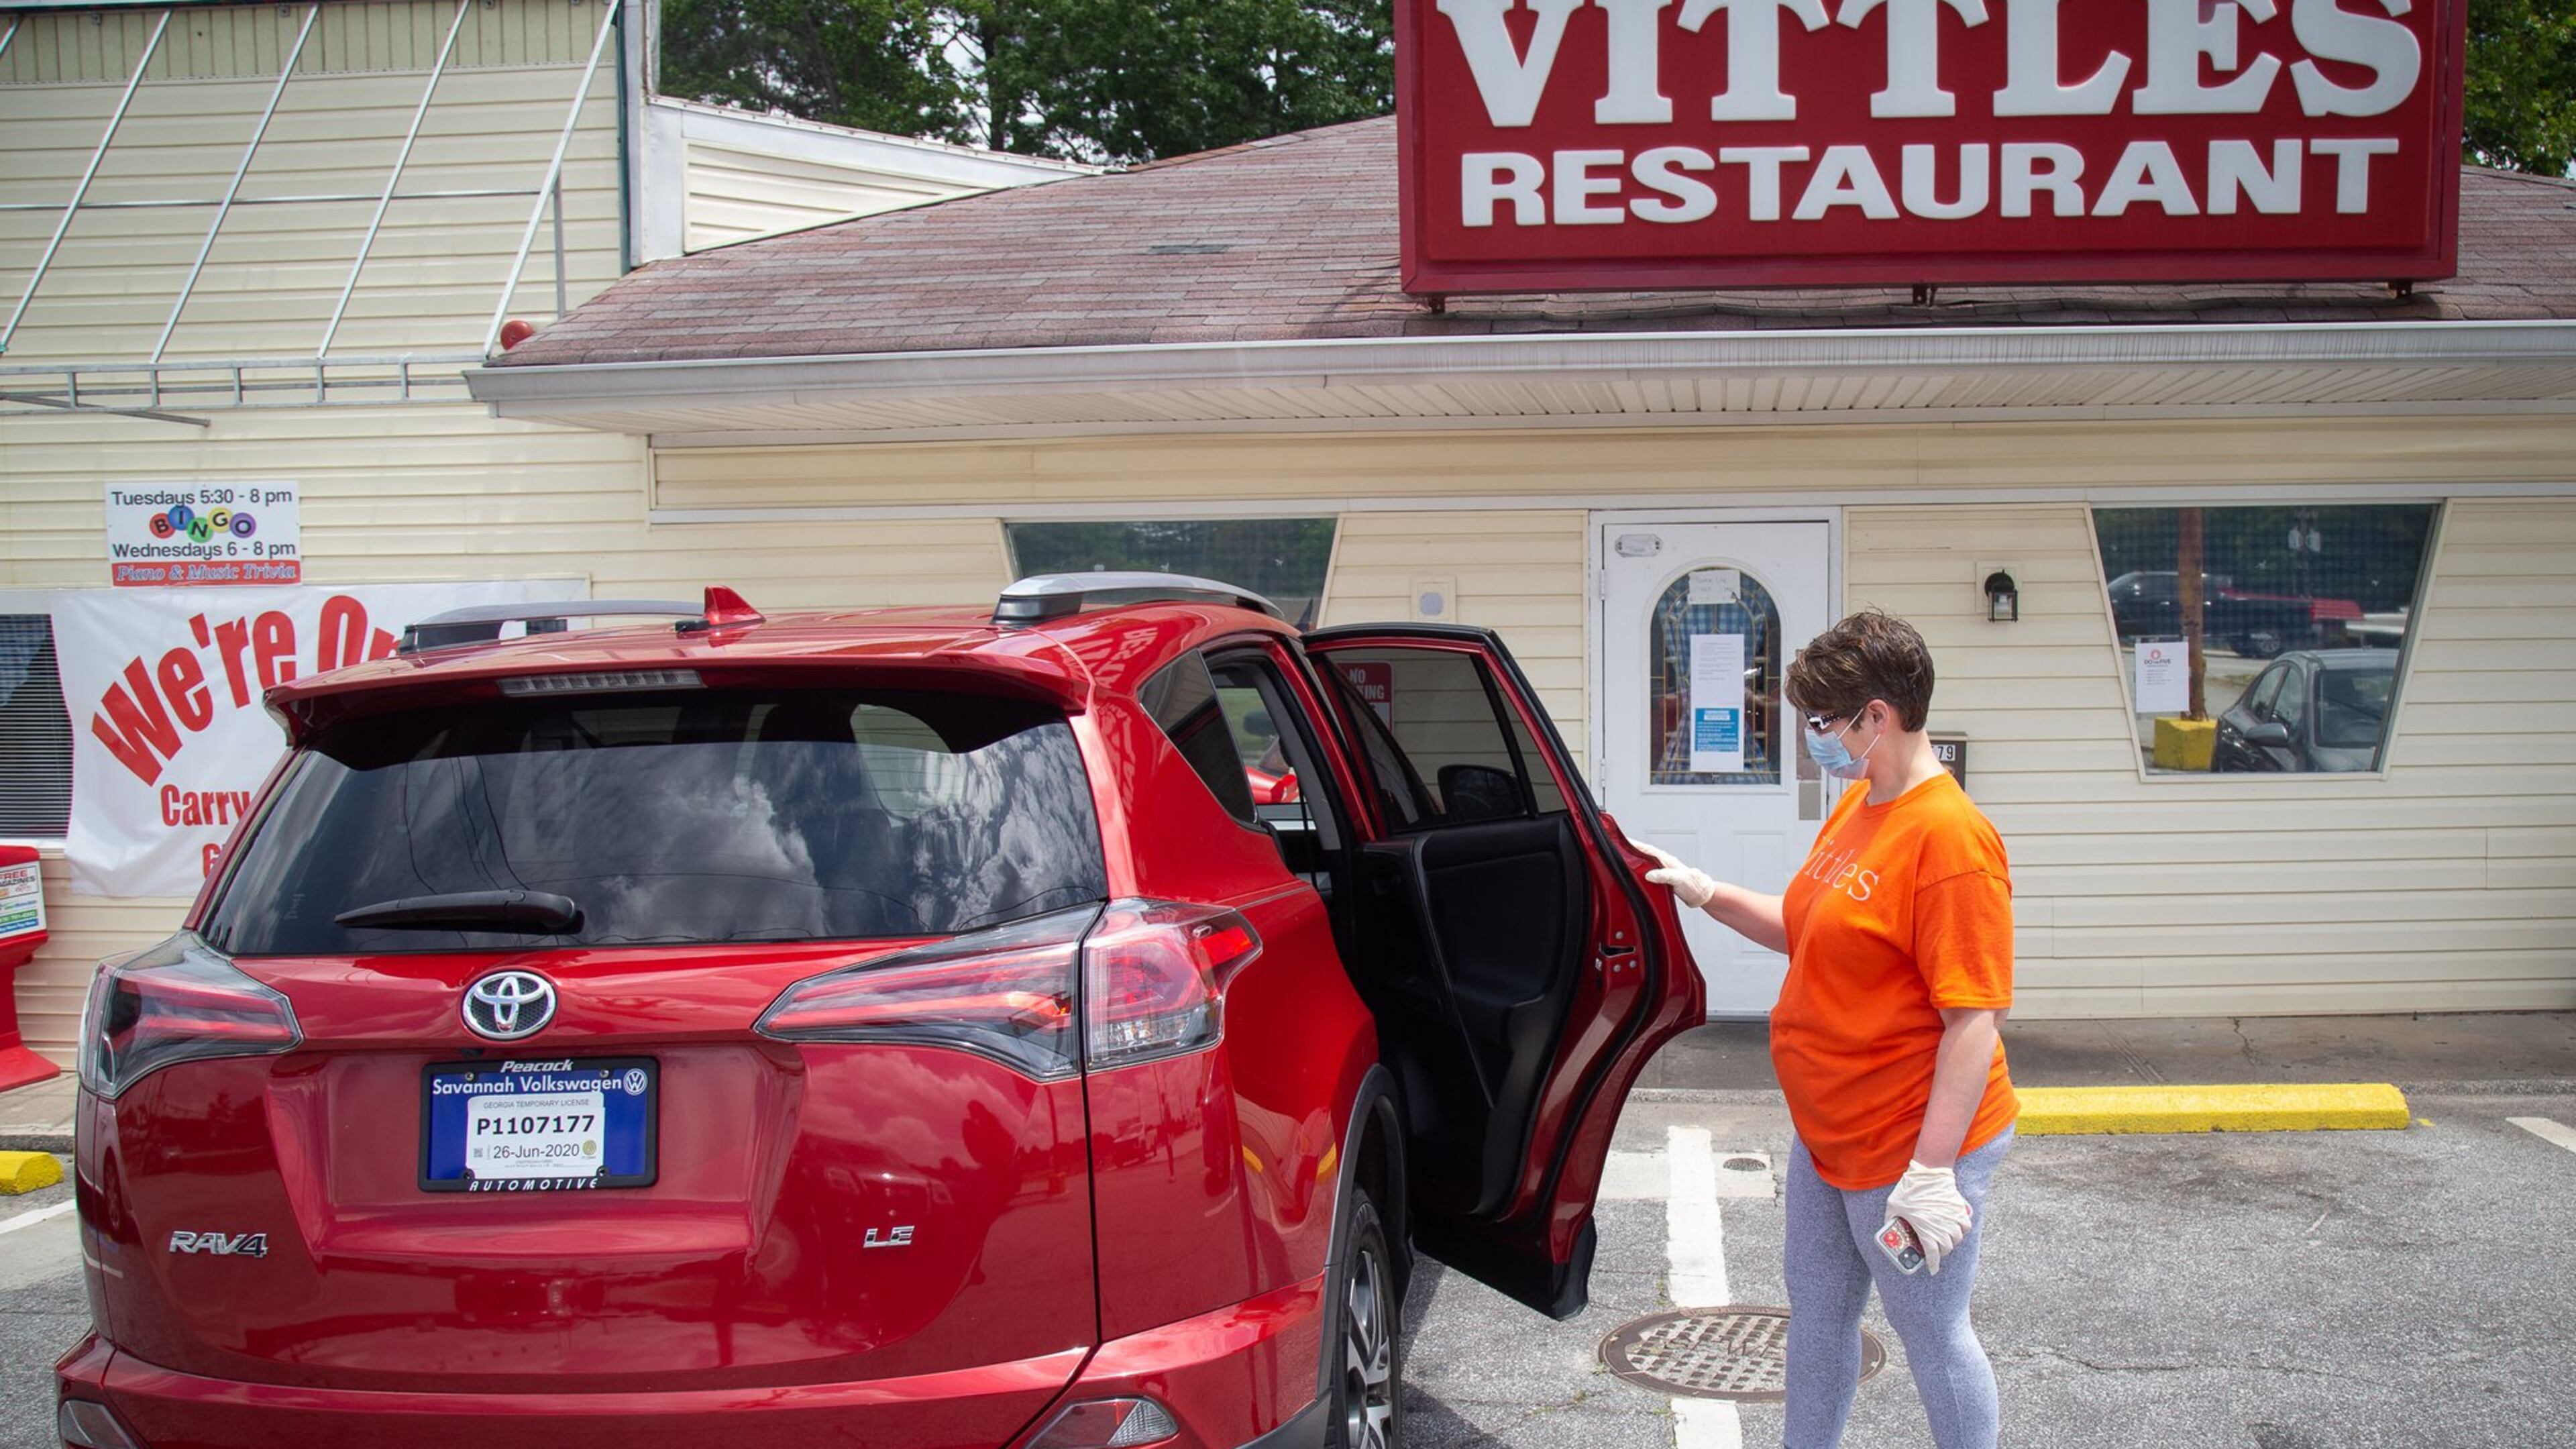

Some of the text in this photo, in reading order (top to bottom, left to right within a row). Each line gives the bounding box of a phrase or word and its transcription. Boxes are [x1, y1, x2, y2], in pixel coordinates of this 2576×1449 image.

[1437, 0, 2422, 127] VITTLES
[1462, 138, 2400, 227] RESTAURANT
[111, 490, 195, 507] Tuesdays
[200, 489, 234, 504] 5:30
[250, 488, 260, 503] 8
[265, 490, 292, 506] pm
[154, 511, 252, 538] BINGO
[113, 542, 223, 560] Wednesdays
[227, 541, 237, 555] 6
[254, 541, 264, 555] 8
[269, 543, 296, 559] pm
[117, 563, 296, 581] Piano & Music Trivia
[1349, 668, 1366, 684] NO
[91, 610, 297, 788] We're
[500, 1059, 575, 1073] Peacock
[433, 1076, 515, 1095] Savannah
[521, 1075, 622, 1093] Volkswagen
[517, 1099, 559, 1108] TEMPORARY
[477, 1115, 595, 1135] P1107177
[494, 1144, 580, 1159] 26-Jun-2020
[470, 1178, 598, 1192] AUTOMOTIVE
[169, 1230, 269, 1258] RAV4
[863, 1226, 915, 1248] LE
